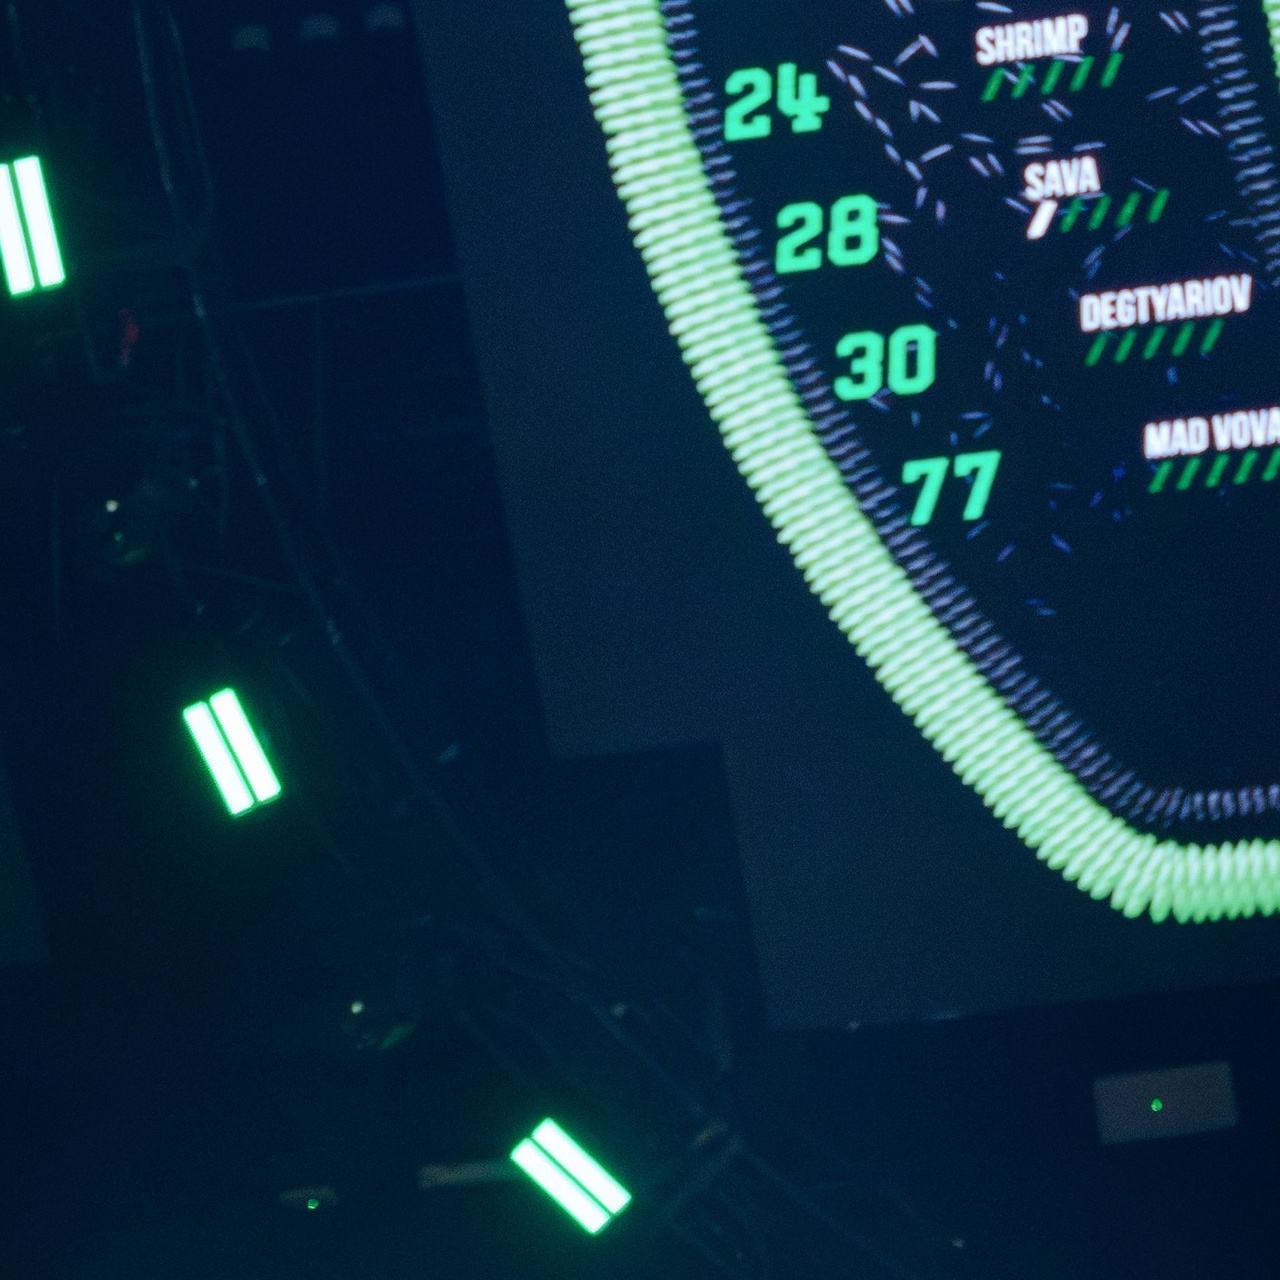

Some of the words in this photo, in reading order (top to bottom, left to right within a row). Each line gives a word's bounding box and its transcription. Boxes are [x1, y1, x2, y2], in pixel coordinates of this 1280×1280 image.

[976, 14, 1088, 66] SHRIMP
[724, 62, 830, 142] 24
[1025, 156, 1101, 201] SAVA
[775, 194, 879, 274] 28
[1080, 275, 1252, 332] DEGTYARIOV
[834, 324, 937, 401] 30
[1144, 417, 1209, 459] MAD
[902, 451, 1001, 526] 77
